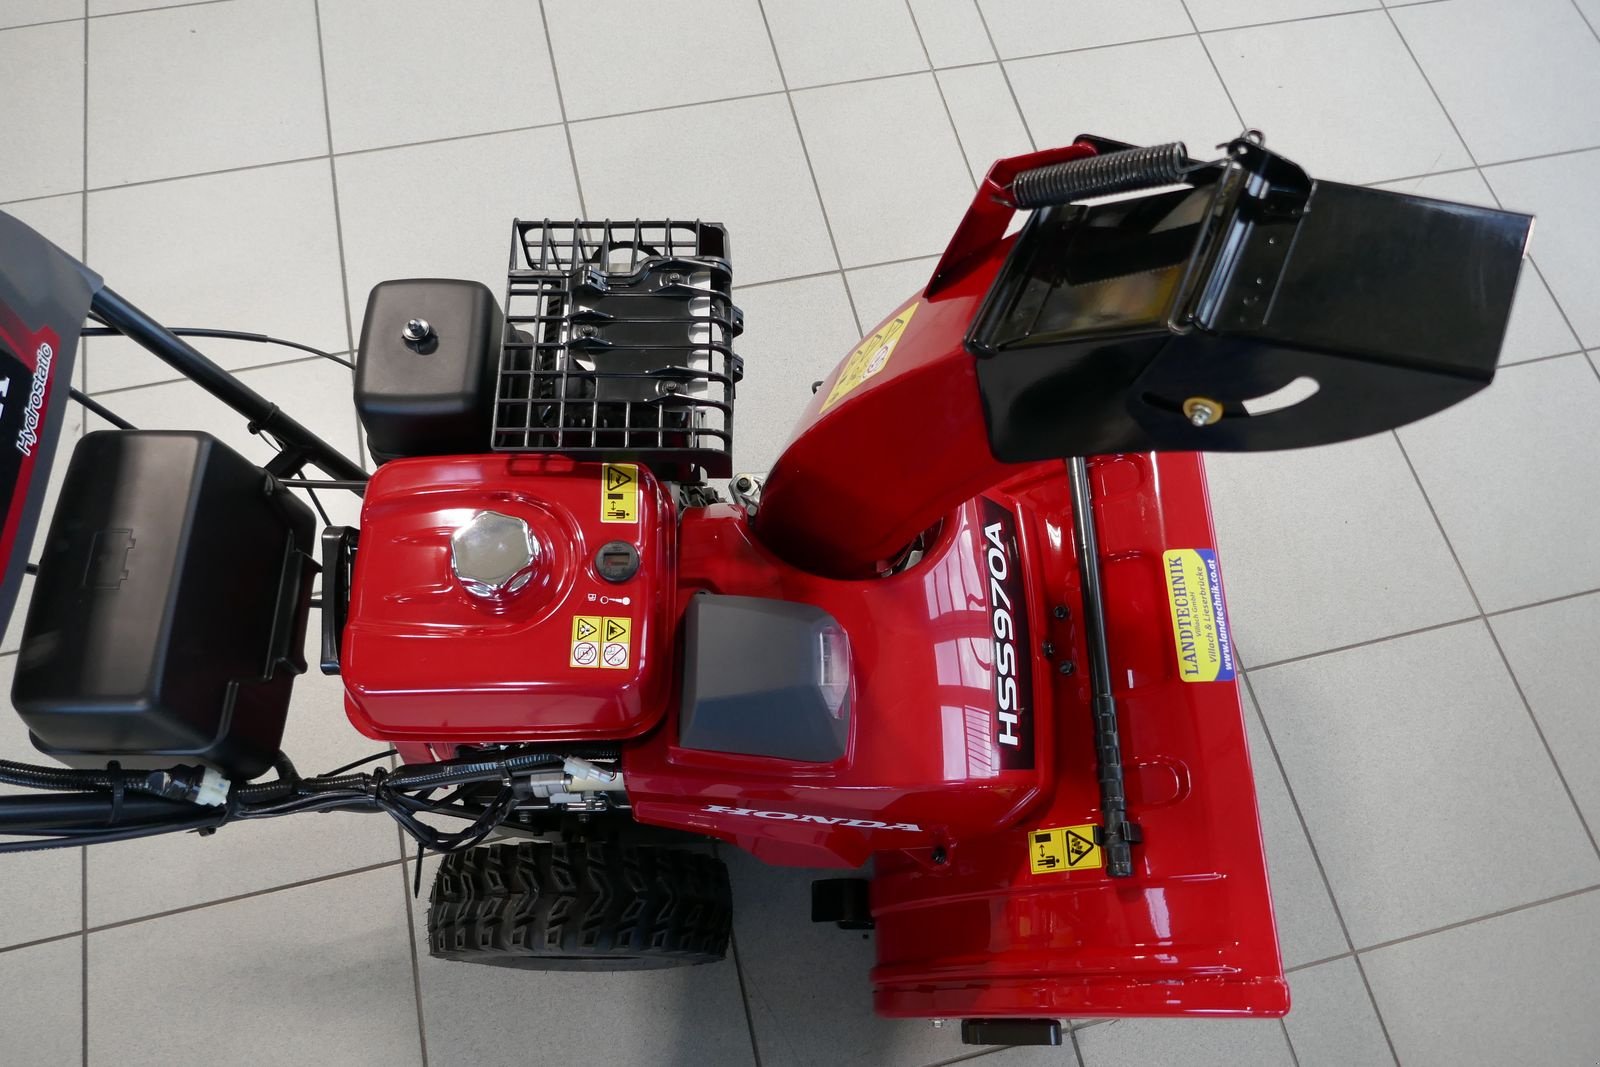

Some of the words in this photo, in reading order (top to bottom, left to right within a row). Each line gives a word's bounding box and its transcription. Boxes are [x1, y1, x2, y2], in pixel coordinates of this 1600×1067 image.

[16, 342, 52, 456] Hydrostatic
[1168, 556, 1199, 675] LANDTECHNIK
[1190, 591, 1198, 613] GmbH
[1196, 566, 1211, 622] Lieserbrücke
[1207, 559, 1232, 671] www.landtechnik.co.at
[984, 521, 1019, 746] HSS970A
[1192, 614, 1202, 637] Villach
[1205, 633, 1217, 663] Villach
[701, 804, 923, 832] HONDA
